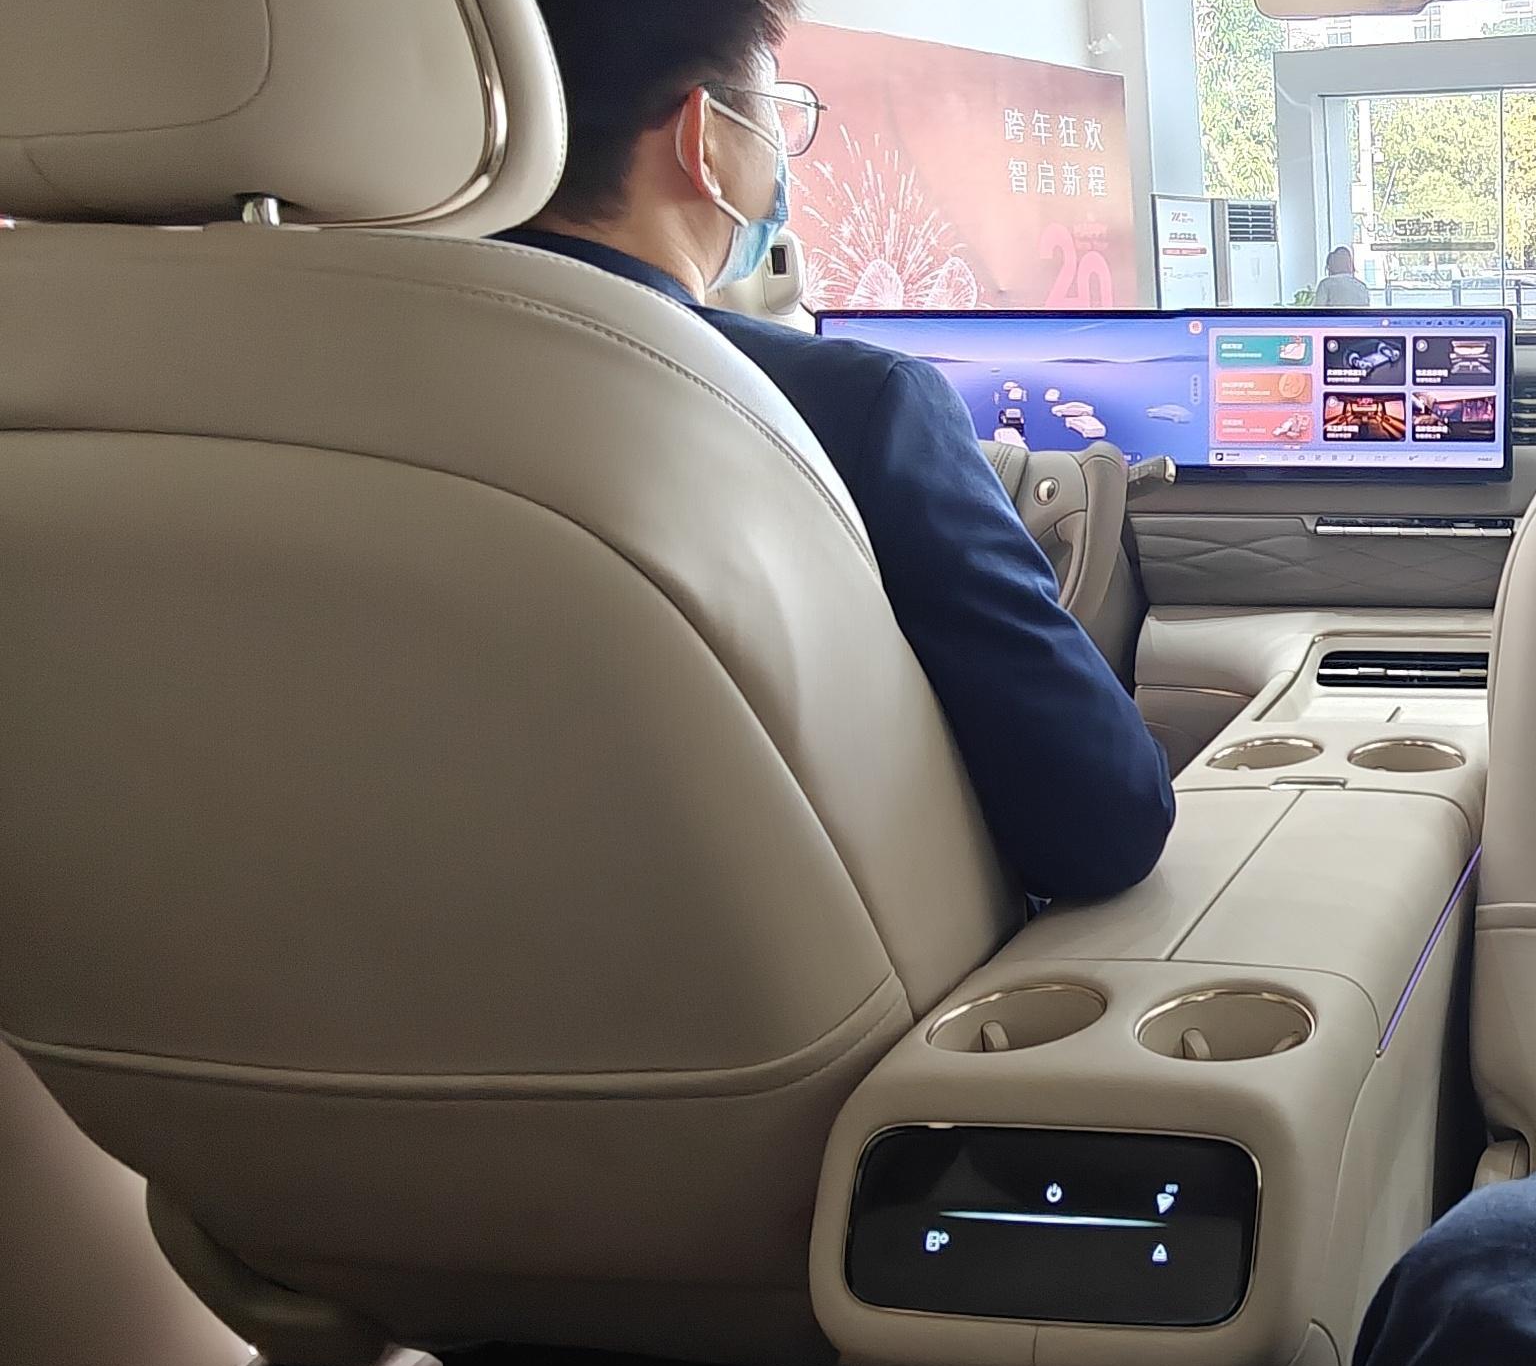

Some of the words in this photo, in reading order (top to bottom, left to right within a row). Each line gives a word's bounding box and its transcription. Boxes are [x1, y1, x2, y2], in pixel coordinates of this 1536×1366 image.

[1003, 108, 1105, 152] 跨年狂欢
[1007, 157, 1108, 197] 智启新程
